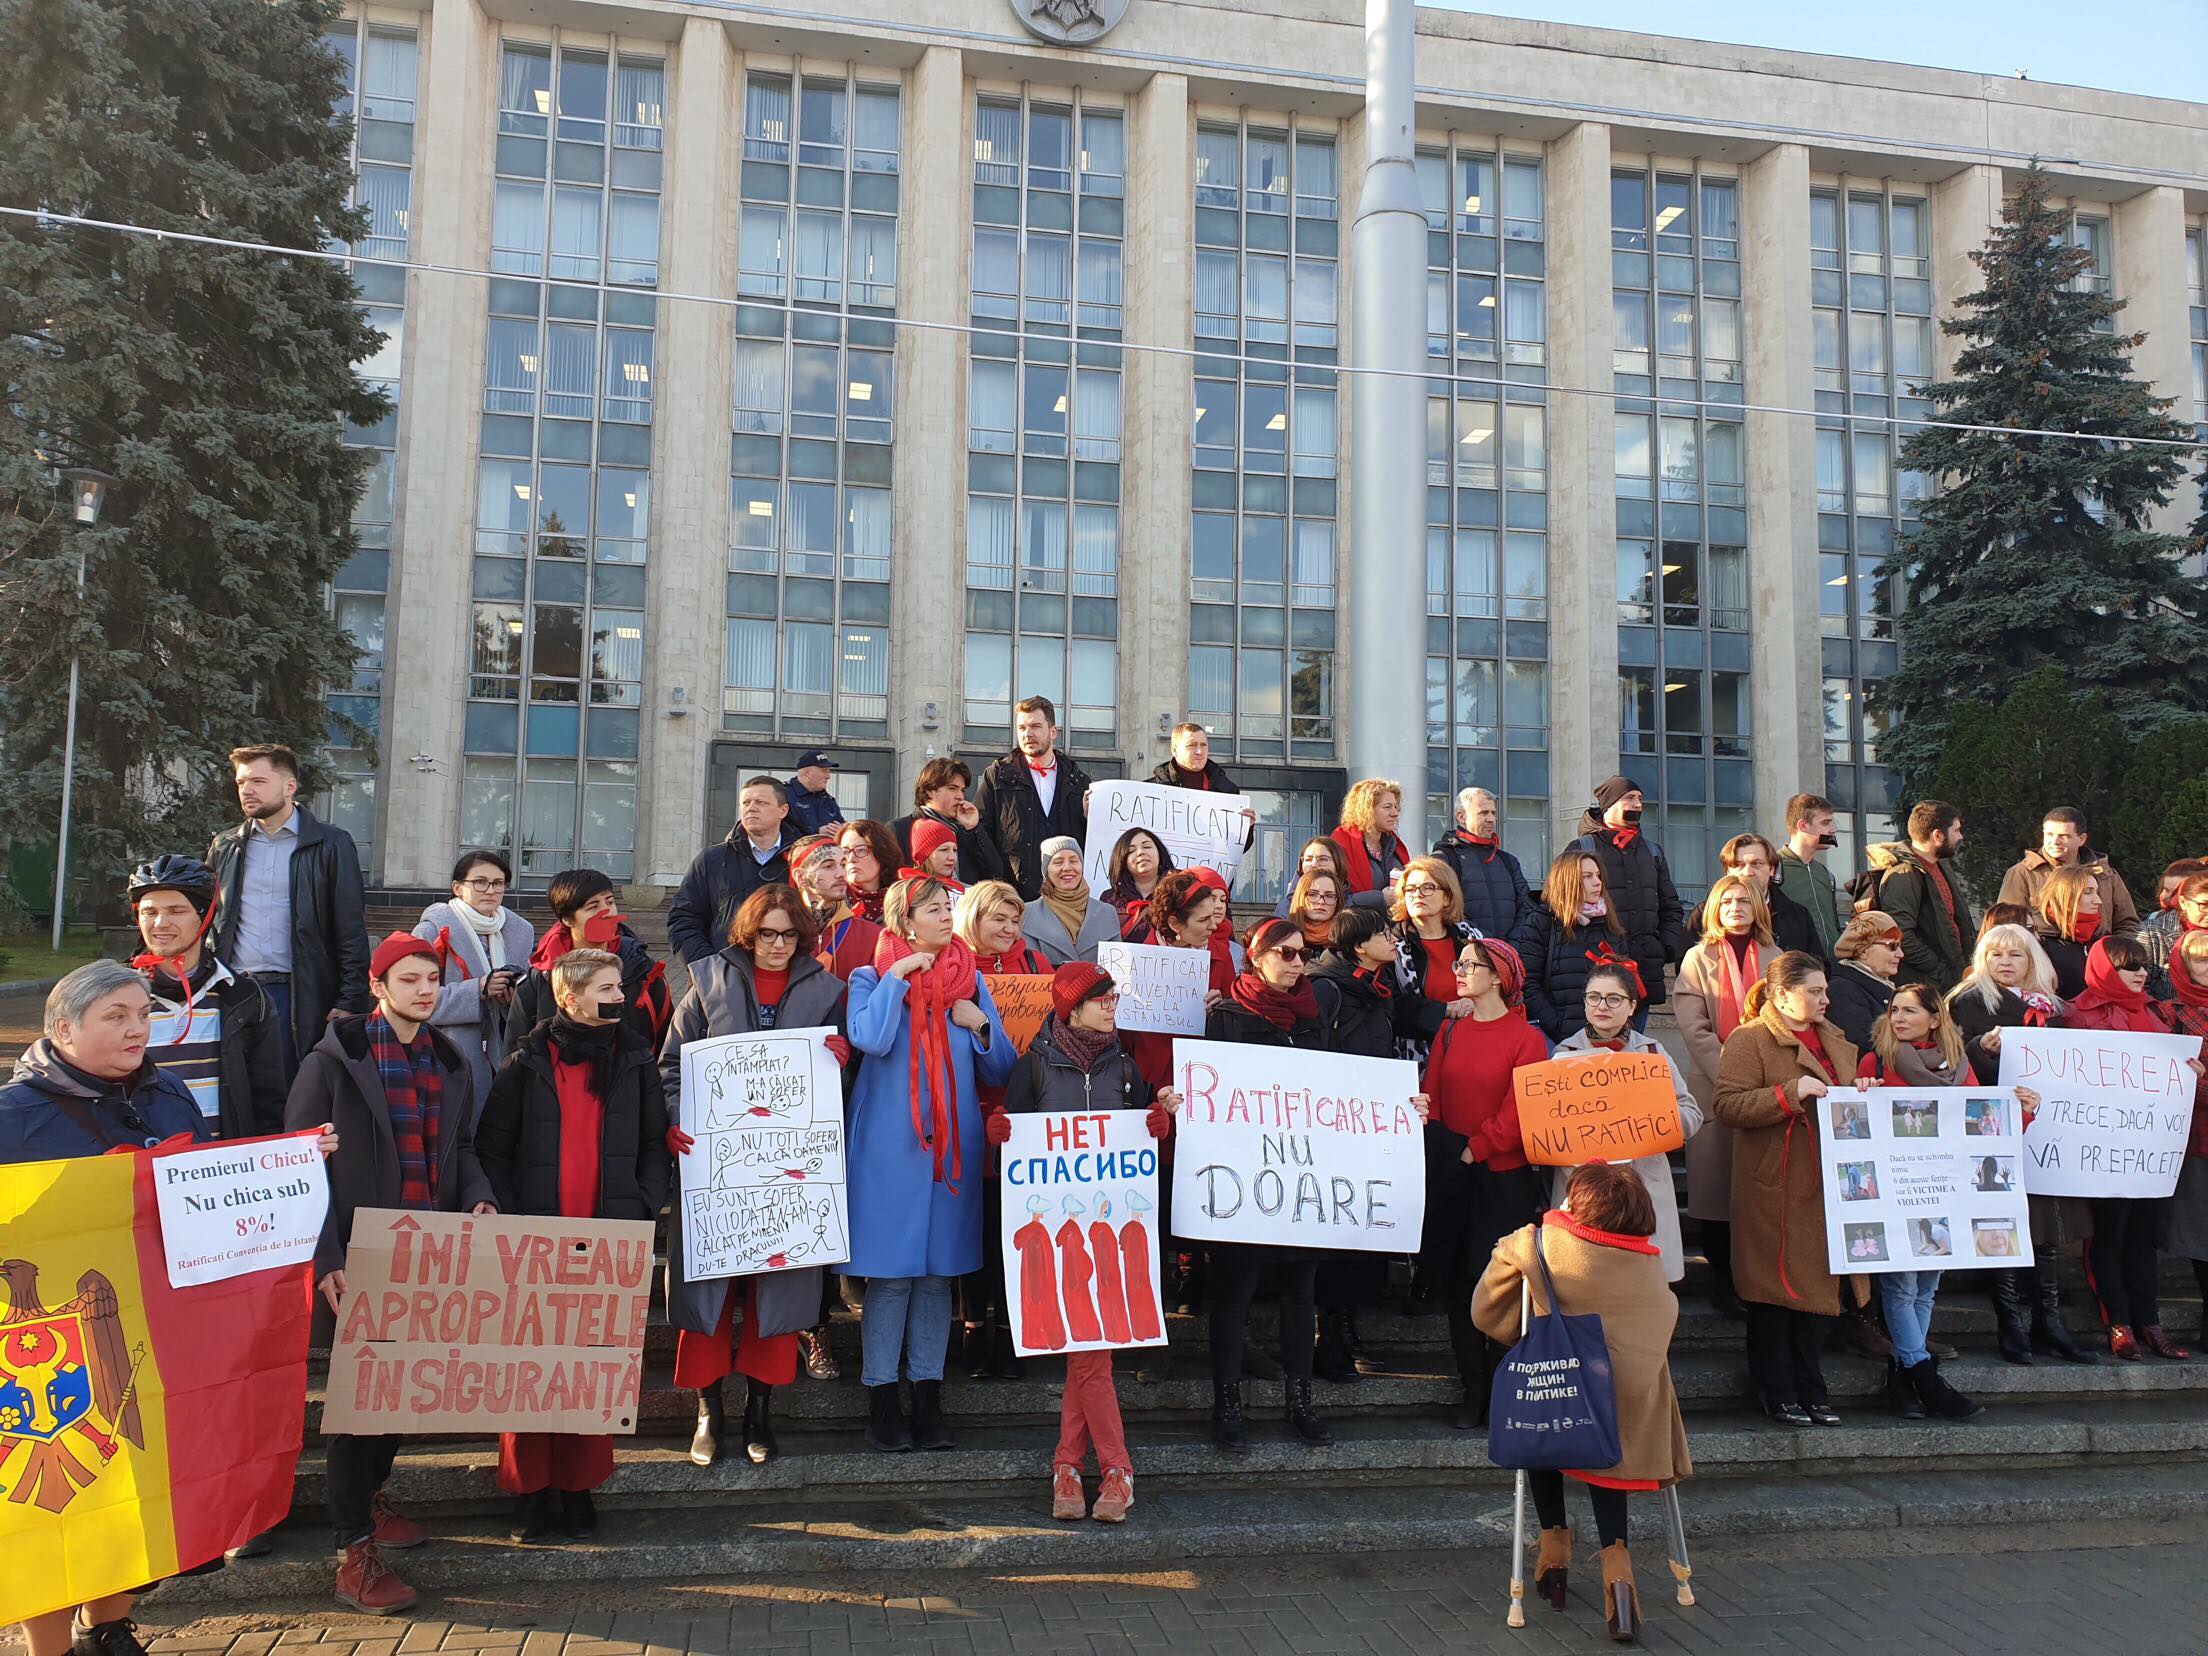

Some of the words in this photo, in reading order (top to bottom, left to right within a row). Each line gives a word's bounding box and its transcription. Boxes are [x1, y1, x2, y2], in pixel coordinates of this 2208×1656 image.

[1121, 983, 1198, 1003] ONVENȚIA
[1133, 1000, 1152, 1010] DE
[1163, 1001, 1179, 1012] LA
[725, 1045, 744, 1062] CE
[1580, 1061, 1671, 1088] COMPLICE
[2018, 1044, 2184, 1096] DUREREA
[746, 1077, 767, 1089] M-A
[747, 1088, 765, 1101] UN
[1549, 1096, 1616, 1118] dacă
[741, 1132, 763, 1151] NU
[1046, 1114, 1112, 1151] НЕТ
[1531, 1126, 1573, 1158] NU
[1577, 1110, 1679, 1150] RATIFICI
[1263, 1132, 1313, 1167] NU
[166, 1157, 255, 1185] Premierul
[259, 1148, 315, 1170] Chicu!
[1008, 1149, 1156, 1185] СПАСИБО
[184, 1194, 216, 1215] Nu
[223, 1187, 273, 1207] chica
[278, 1179, 310, 1198] sub
[693, 1193, 711, 1214] EU
[717, 1188, 760, 1208] SUNT
[1195, 1162, 1395, 1229] DOARE
[1913, 1185, 1948, 1194] VICTIME
[1950, 1185, 1956, 1193] A
[235, 1213, 275, 1237] 8%!
[270, 1241, 281, 1251] de
[283, 1239, 292, 1248] la
[388, 1214, 474, 1286] ÎMI
[496, 1234, 646, 1288] VREAU
[738, 1232, 750, 1249] PE
[698, 1258, 727, 1274] DU-TE
[340, 1284, 650, 1348] APROPIATELE
[354, 1344, 405, 1412] ÎN
[410, 1349, 640, 1423] SIGURANȚĂ
[1516, 1389, 1524, 1400] В
